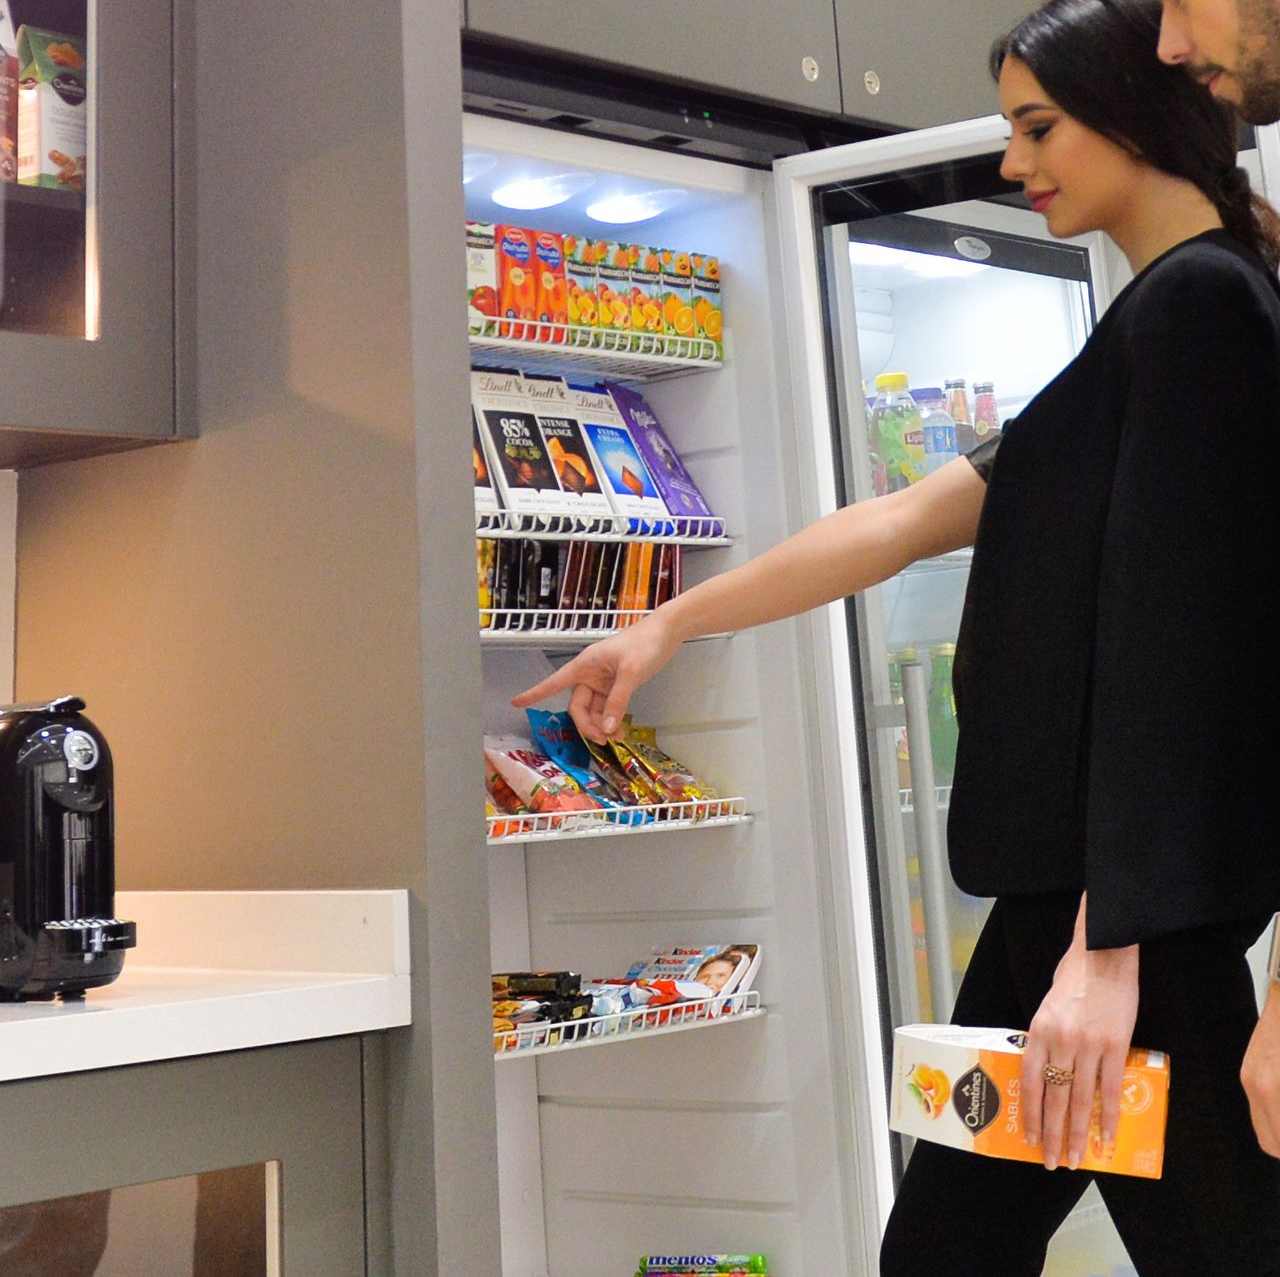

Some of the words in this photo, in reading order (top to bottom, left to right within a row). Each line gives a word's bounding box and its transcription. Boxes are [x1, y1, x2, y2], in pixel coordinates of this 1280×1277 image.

[479, 377, 513, 393] Lindt
[500, 418, 531, 438] 85%
[965, 1072, 982, 1127] Orientines
[648, 1255, 718, 1266] mentos
